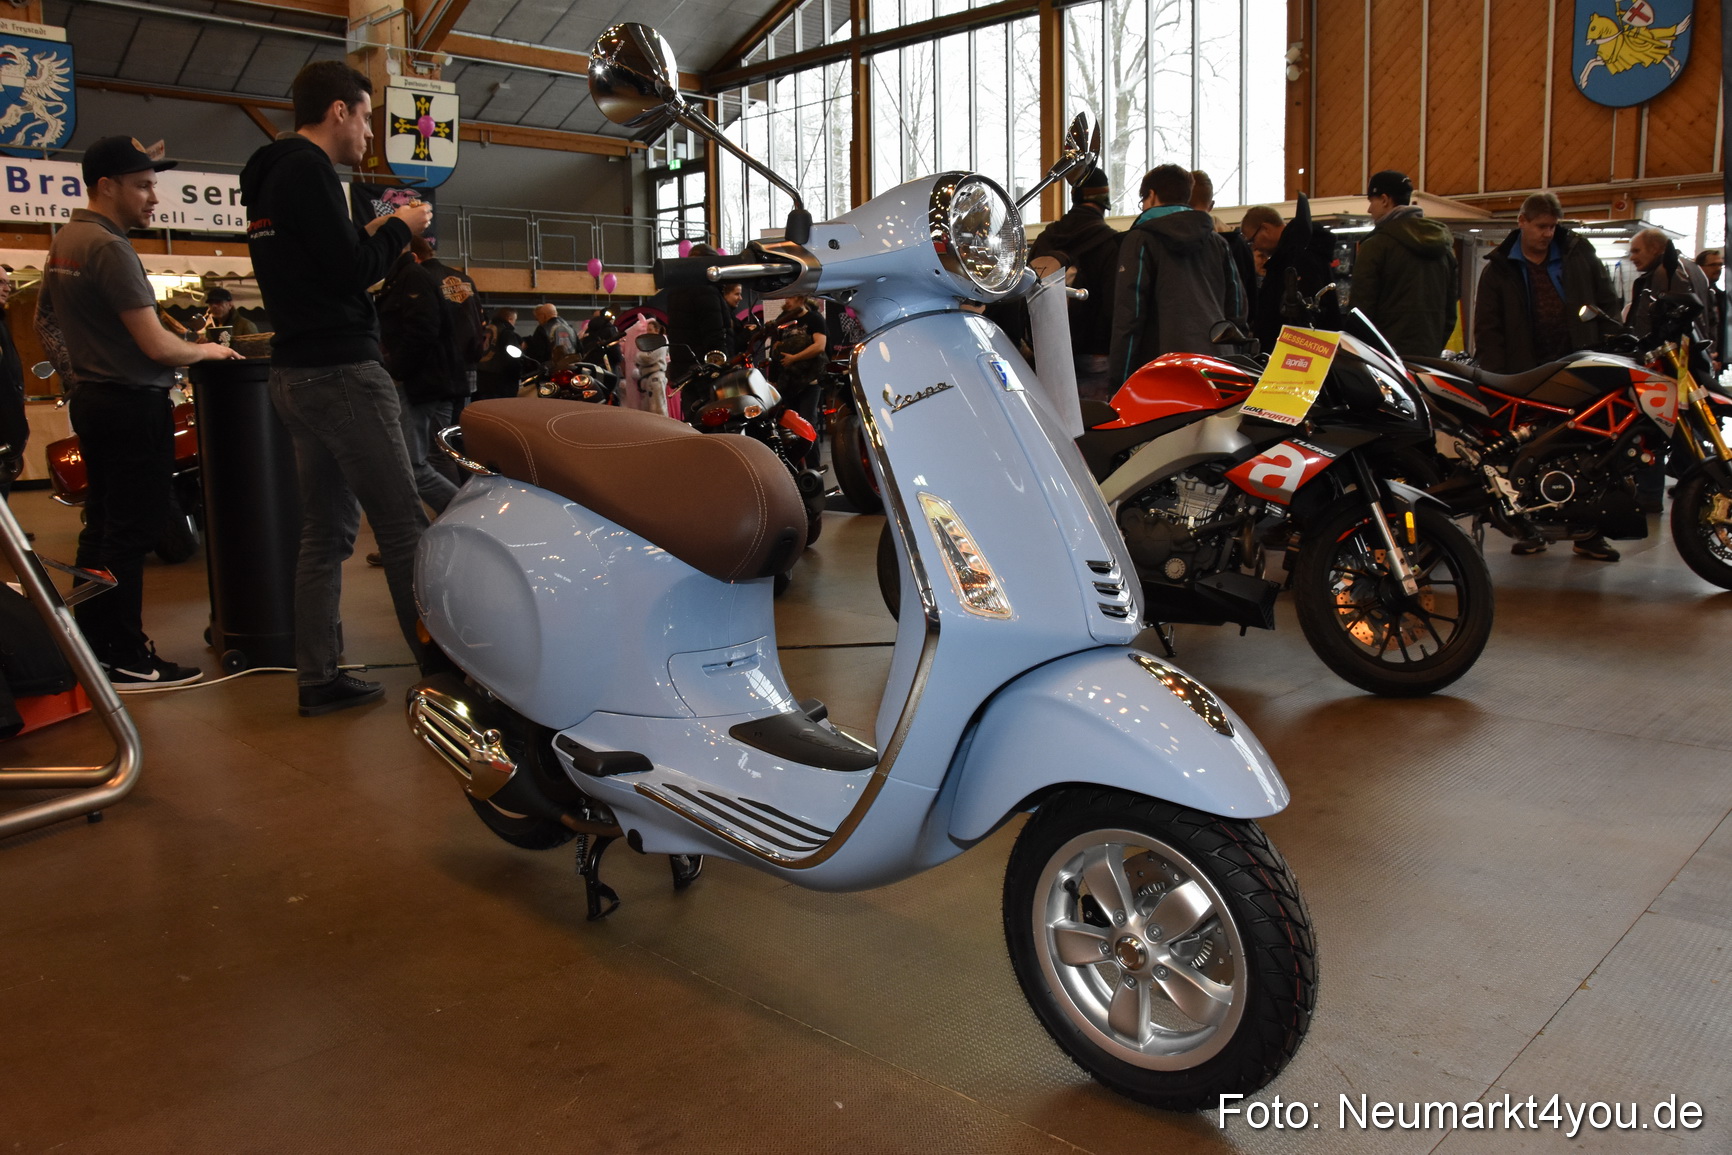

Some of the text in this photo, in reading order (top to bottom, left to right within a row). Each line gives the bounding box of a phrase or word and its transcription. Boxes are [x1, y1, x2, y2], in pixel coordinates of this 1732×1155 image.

[6, 165, 241, 206] Bra ser
[10, 202, 71, 218] einfa
[213, 213, 243, 227] Gla
[1282, 331, 1330, 355] MESSEAKTION
[1285, 358, 1309, 369] aprilia
[882, 381, 954, 414] Vespa
[1292, 438, 1337, 458] TUONO
